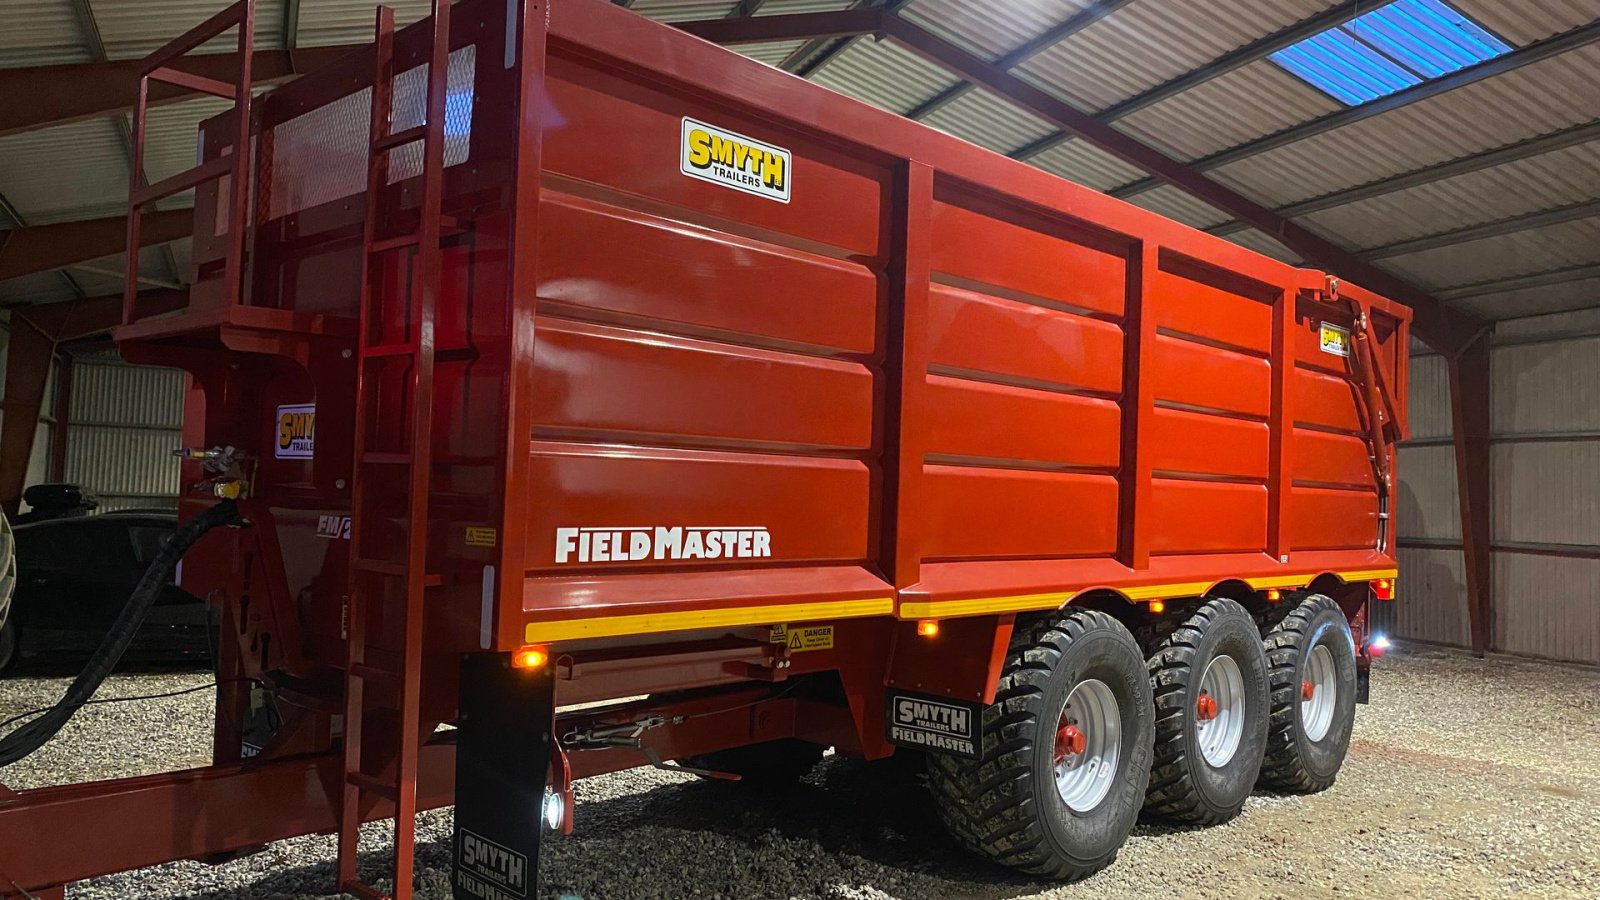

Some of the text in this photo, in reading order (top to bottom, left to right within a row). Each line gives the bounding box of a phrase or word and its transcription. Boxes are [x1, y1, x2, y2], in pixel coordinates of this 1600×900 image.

[689, 129, 784, 191] SMYTH
[713, 166, 760, 187] TRAILERS
[280, 413, 315, 449] SMY
[292, 442, 313, 451] TRAILE
[317, 515, 351, 540] FM/2
[804, 628, 831, 637] DANGER
[899, 701, 966, 733] SMYTH
[916, 719, 950, 731] TRAILERS
[464, 835, 523, 888] SMYTH
[457, 870, 511, 900] FIELDMA
